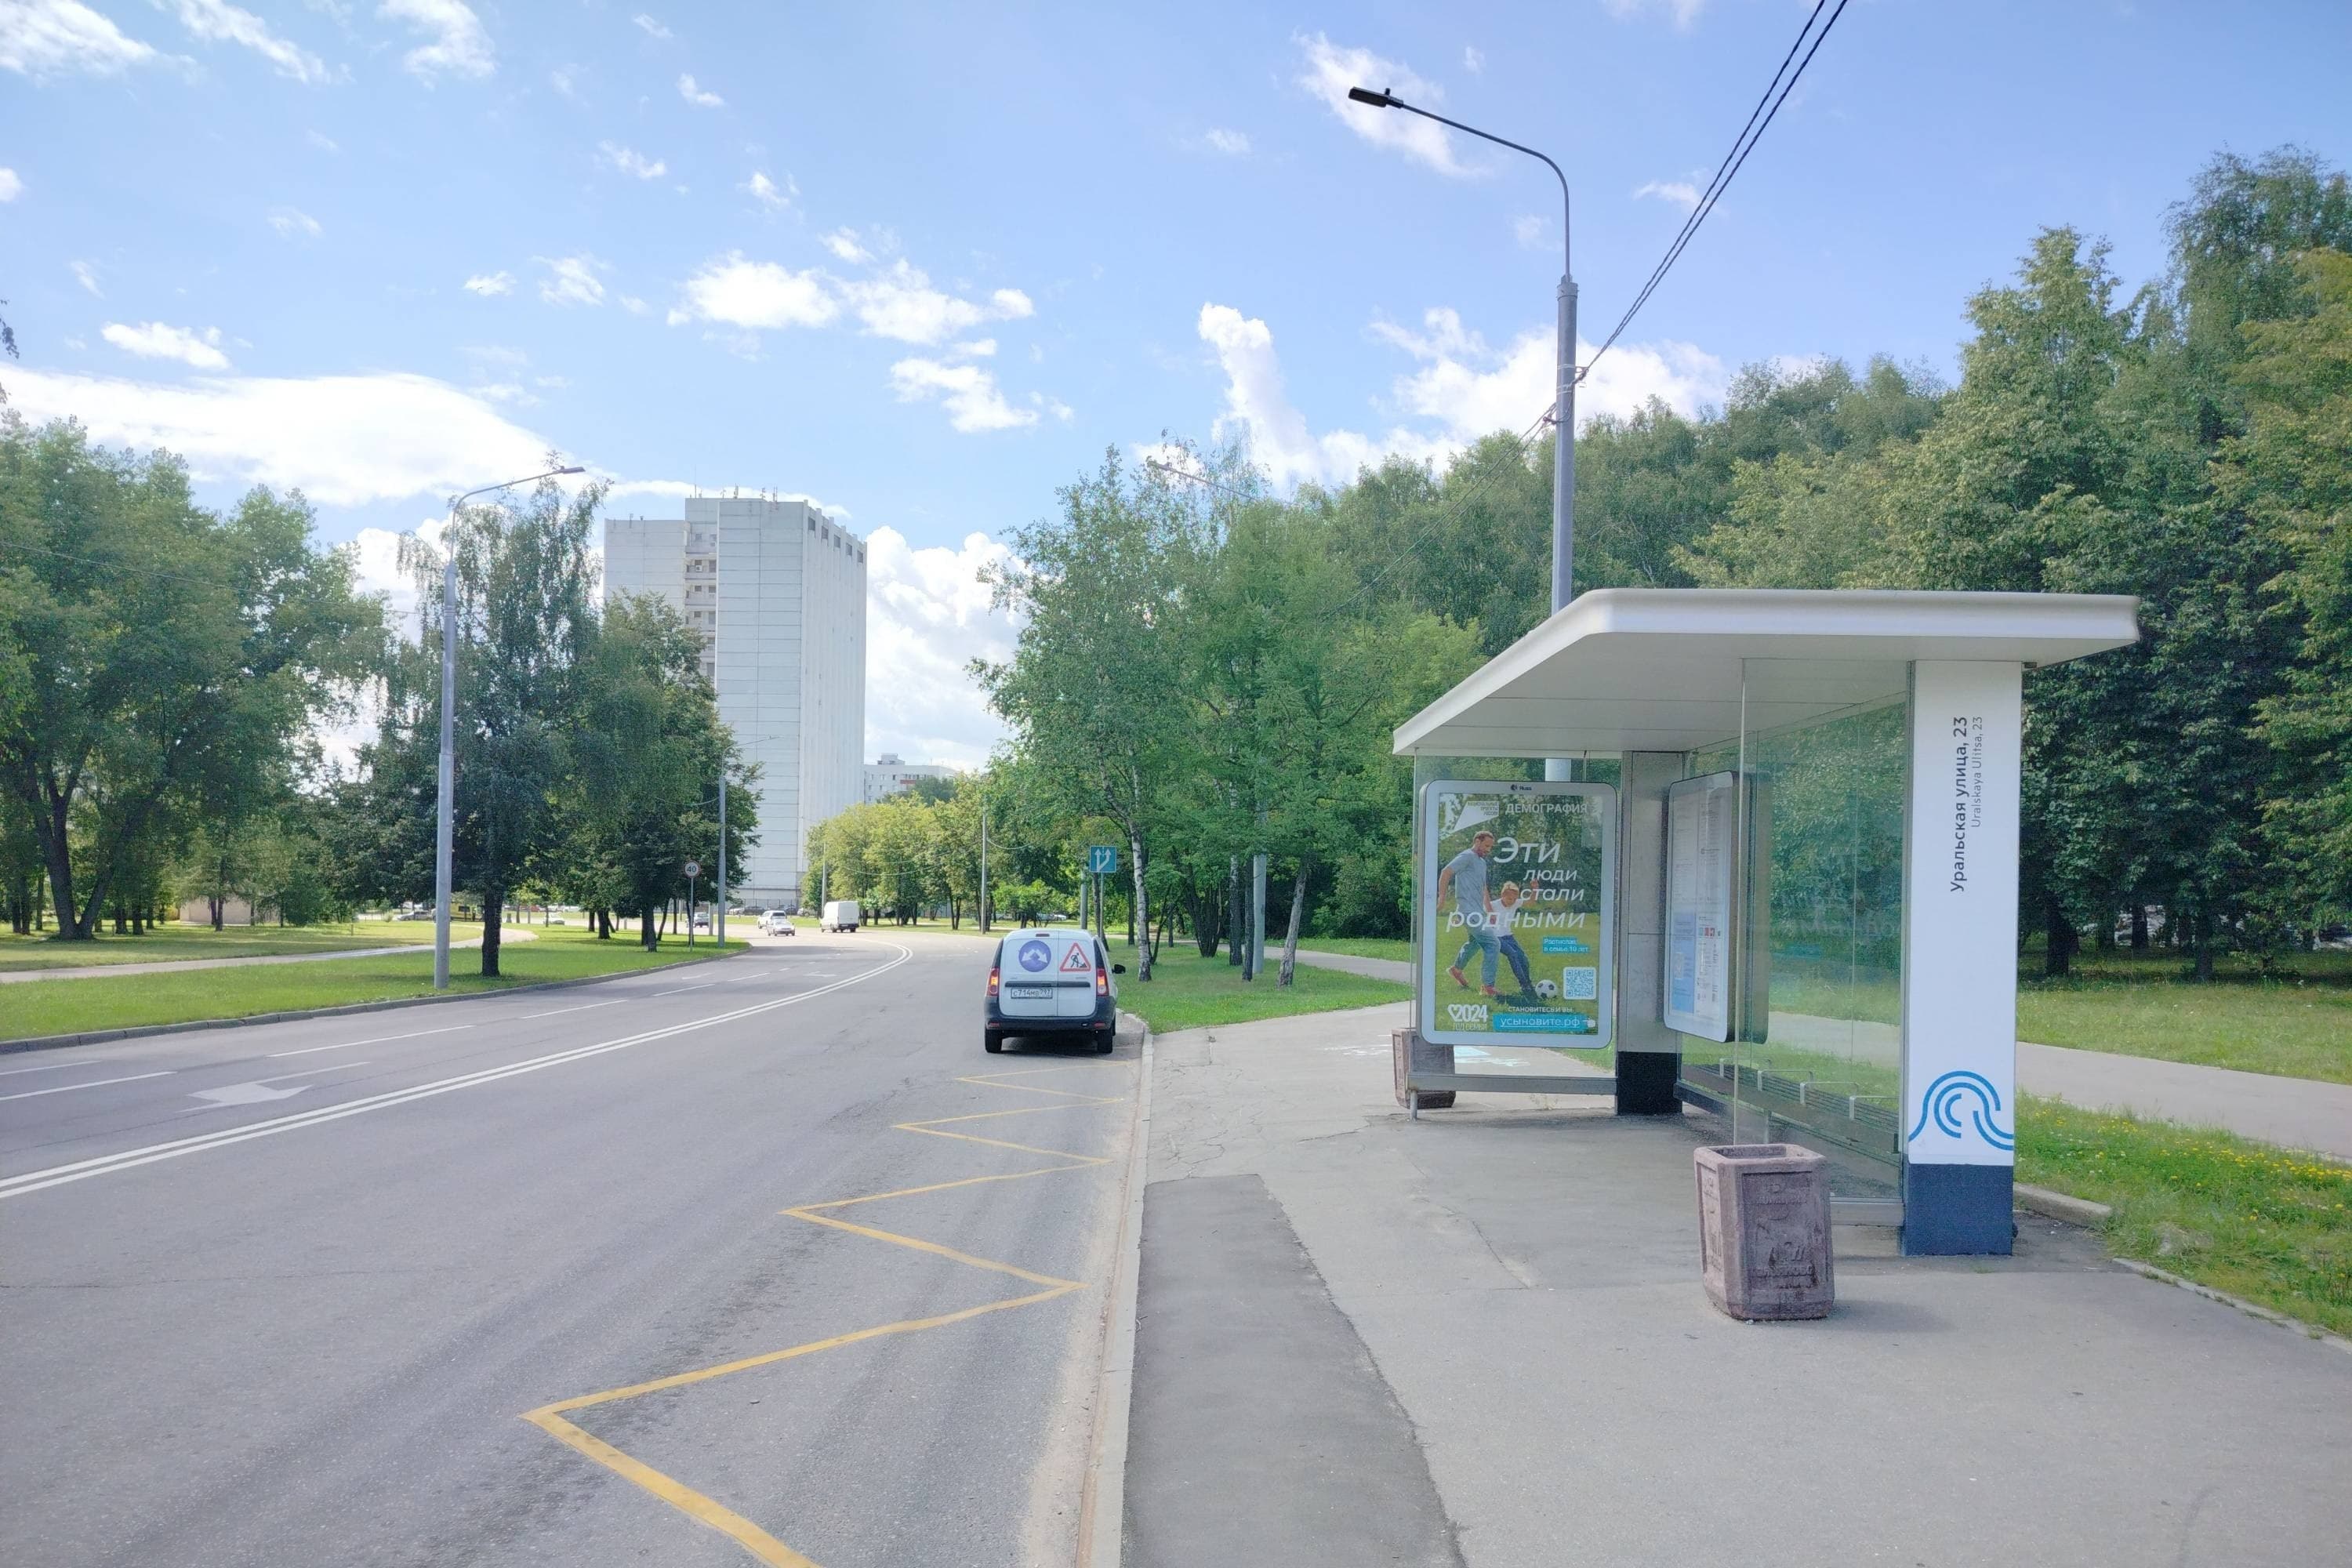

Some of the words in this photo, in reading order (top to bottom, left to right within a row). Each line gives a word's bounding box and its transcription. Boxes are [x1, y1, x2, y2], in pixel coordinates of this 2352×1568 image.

[1953, 717, 1968, 738] 23
[1972, 716, 1983, 731] 23
[1972, 734, 1984, 769] Ulitsa,
[1955, 742, 1970, 798] улица,
[1504, 803, 1588, 816] ДЕМОГРАФИЯ
[1971, 772, 1984, 828] Uralskaya
[1493, 837, 1561, 863] Эти
[1950, 802, 1968, 892] Уральская
[1523, 869, 1577, 883] люди
[1520, 888, 1584, 901] стали
[1446, 911, 1587, 933] родными
[1453, 1004, 1489, 1022] 2024
[1500, 1016, 1581, 1029] усыновите.рф
